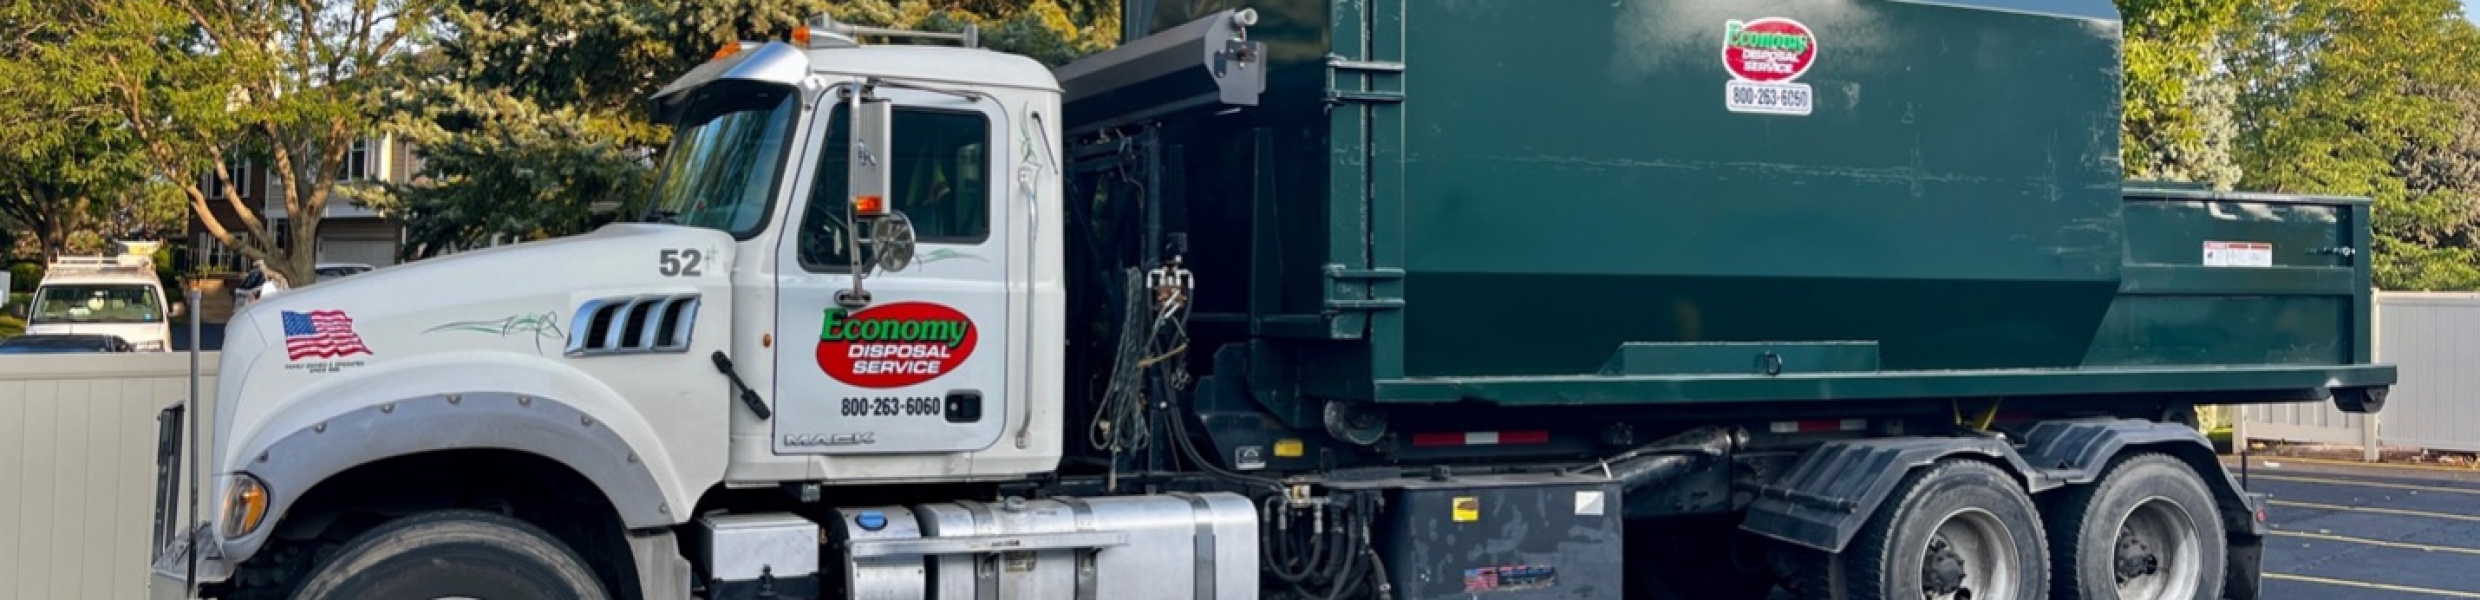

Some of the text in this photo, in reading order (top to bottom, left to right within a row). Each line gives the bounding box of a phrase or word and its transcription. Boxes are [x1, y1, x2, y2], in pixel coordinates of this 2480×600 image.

[1727, 22, 1808, 54] Economy
[1742, 48, 1800, 62] DISPOSAL
[1742, 61, 1793, 73] SERVICE
[659, 249, 702, 277] 52
[820, 308, 969, 349] Economy
[848, 343, 951, 358] DISPOSAL
[852, 360, 941, 374] SERVICE
[841, 397, 941, 417] 800-263-6060
[784, 432, 875, 446] MACK
